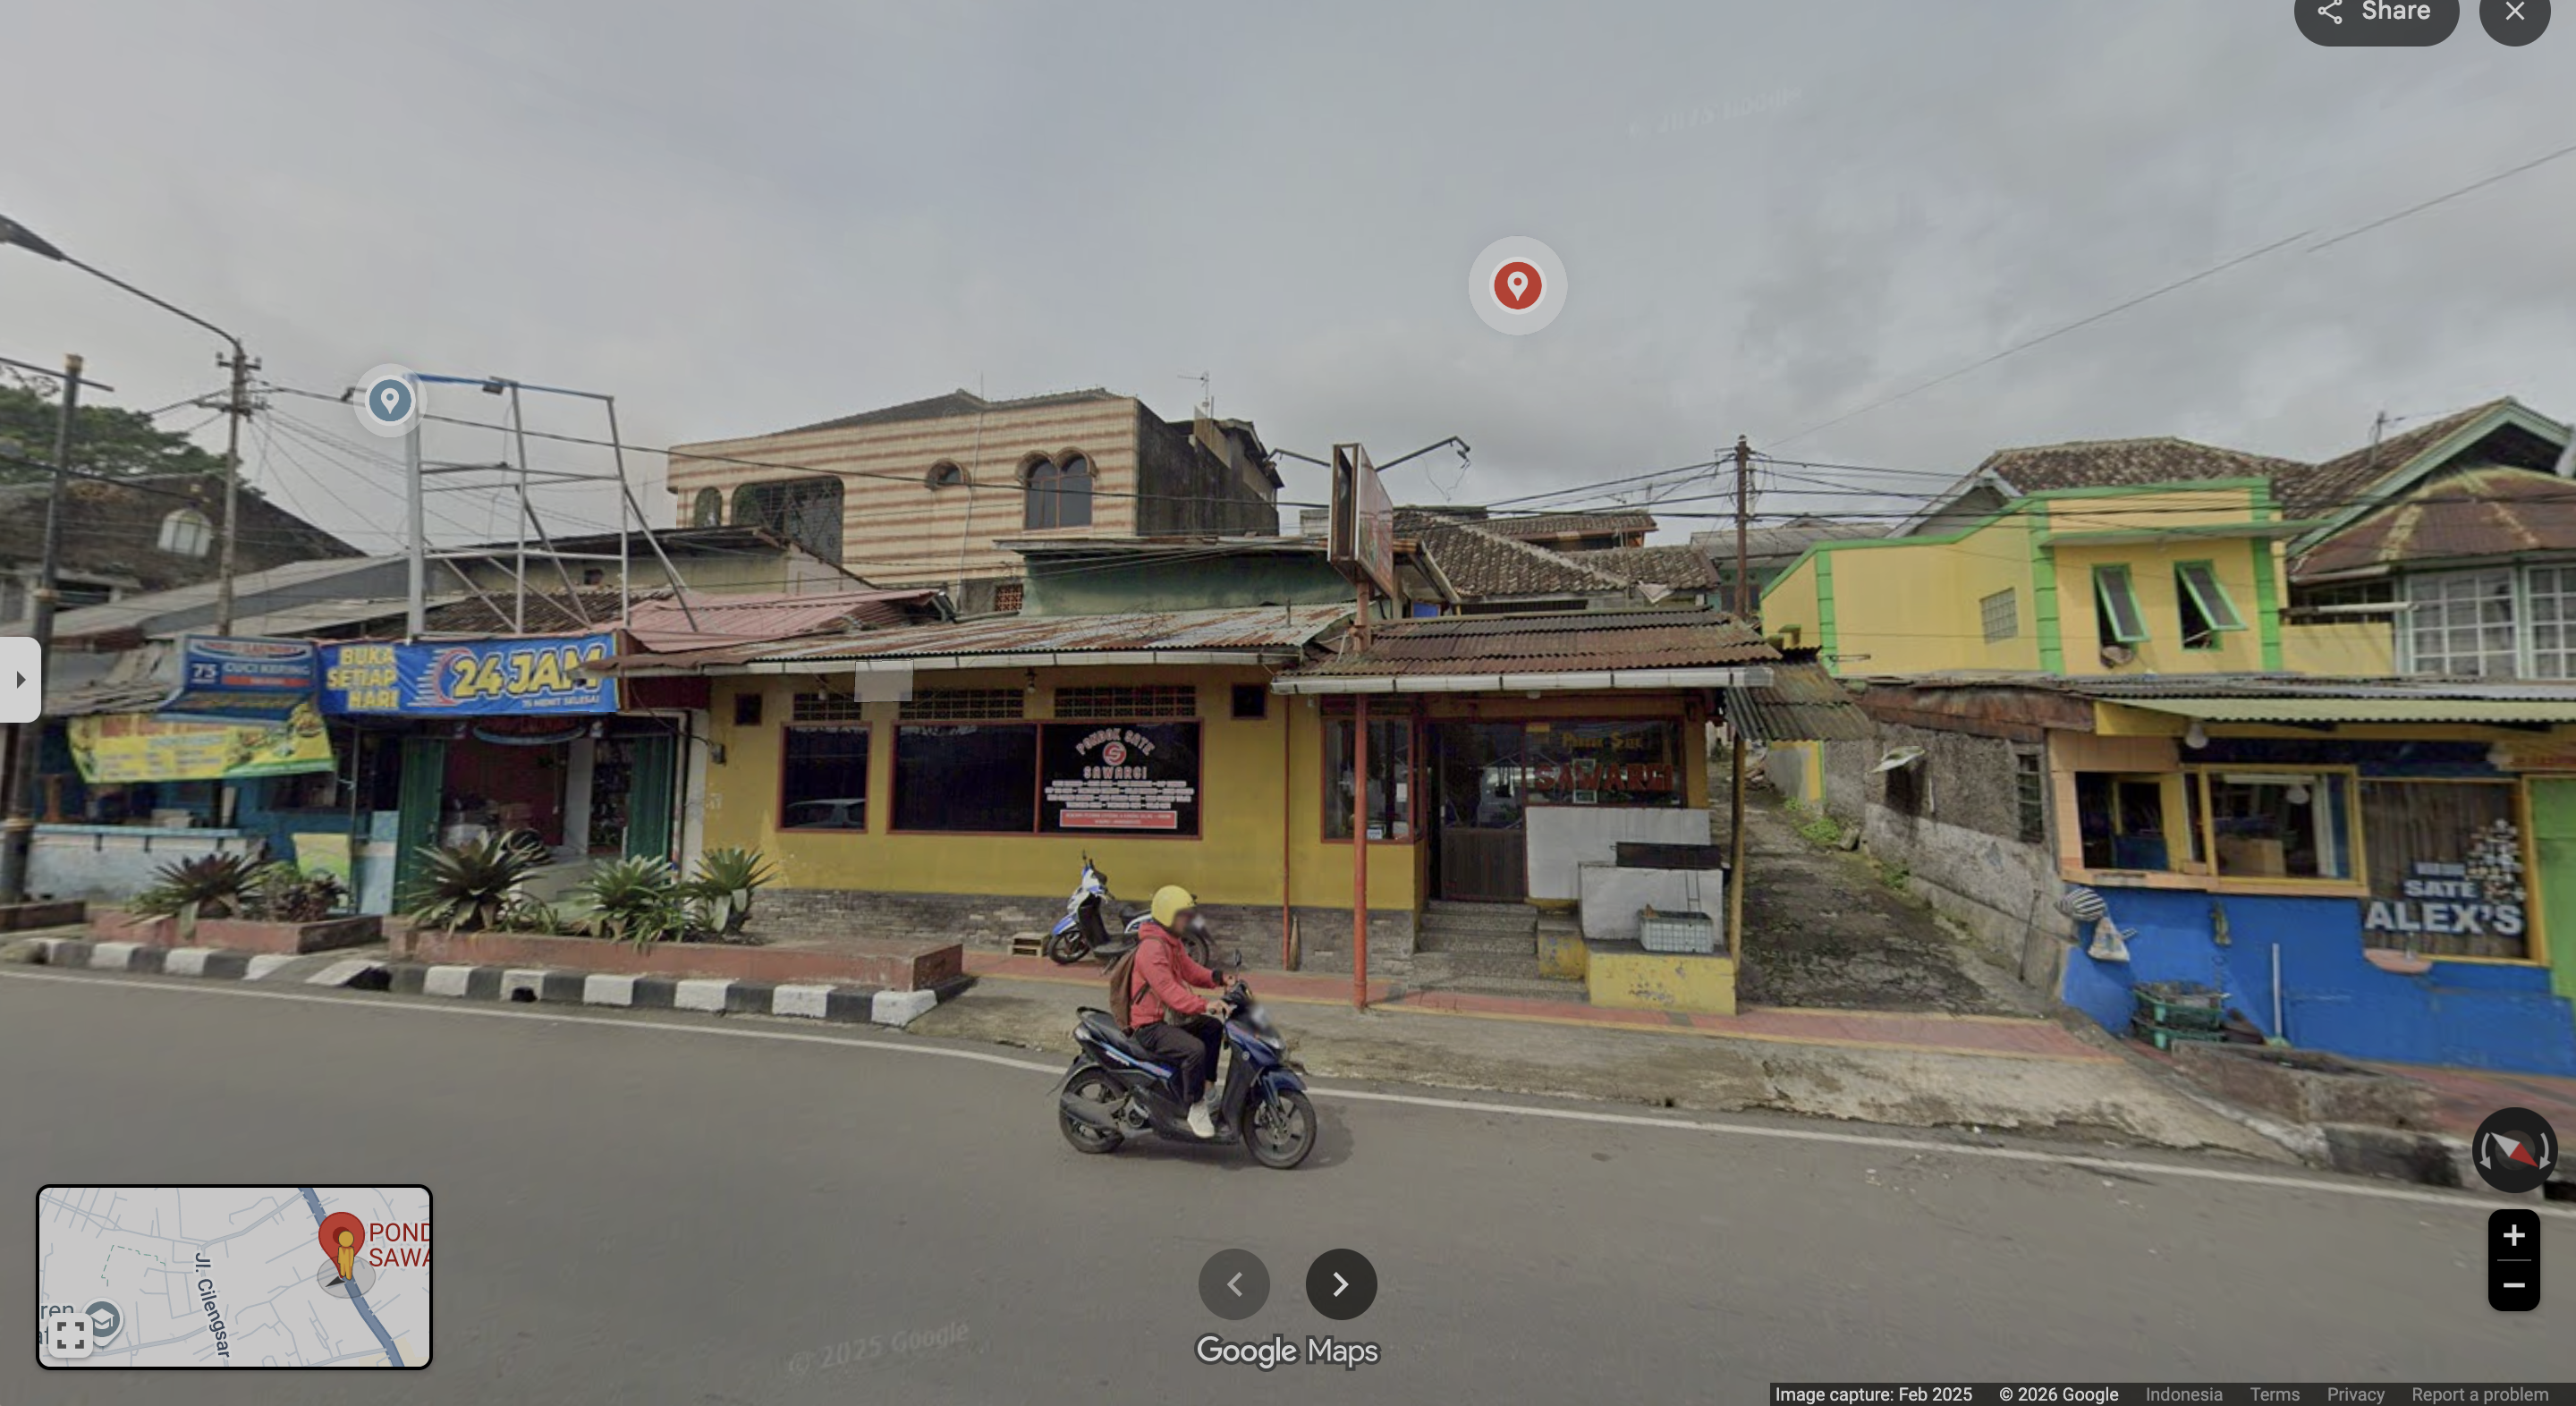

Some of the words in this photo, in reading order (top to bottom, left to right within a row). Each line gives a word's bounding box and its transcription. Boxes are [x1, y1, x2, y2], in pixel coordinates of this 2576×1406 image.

[339, 646, 397, 666] BUKA
[326, 666, 398, 690] SETIAP
[453, 654, 504, 699] 24
[509, 644, 604, 694] JAM
[346, 688, 401, 711] HARI
[1075, 727, 1122, 756] PONDOK
[1123, 729, 1156, 756] SATE
[1083, 766, 1148, 780] SAWARGI
[2403, 879, 2478, 899] SATE
[2365, 901, 2523, 936] ALEX'S
